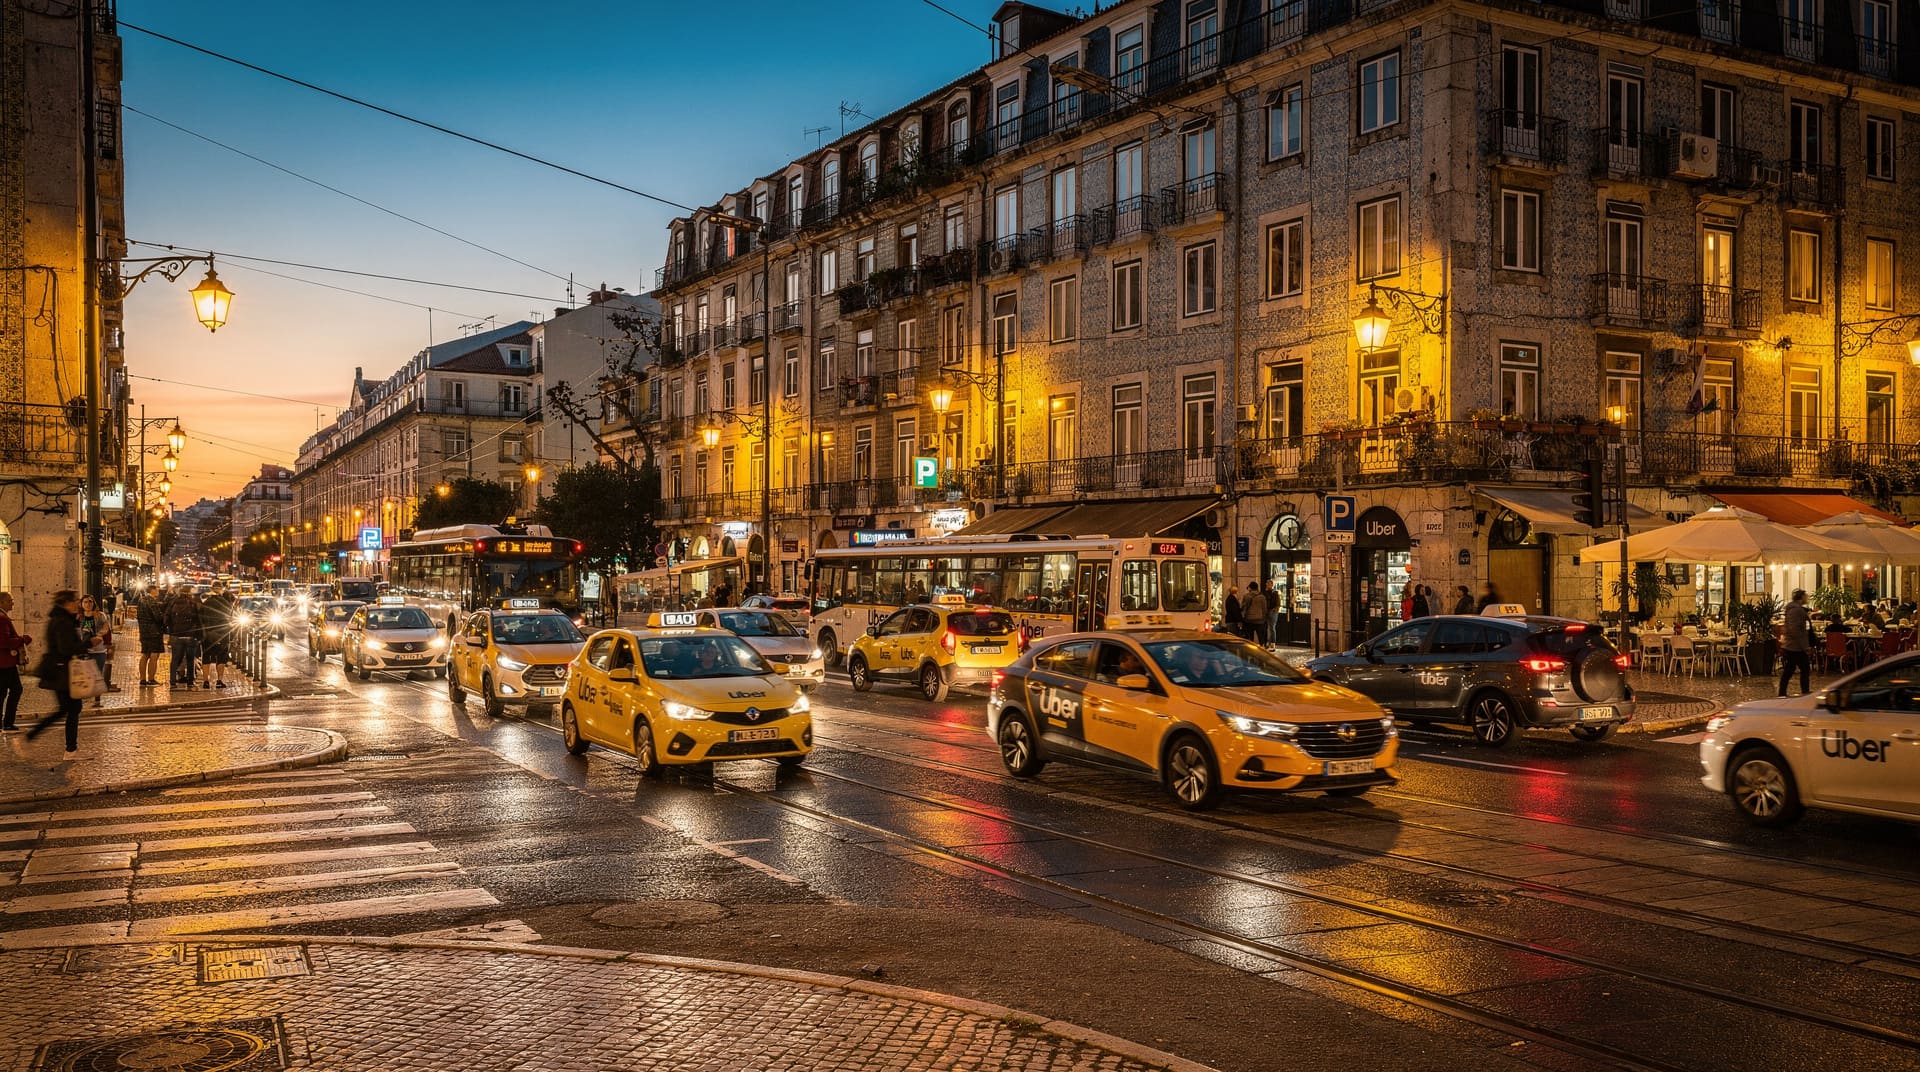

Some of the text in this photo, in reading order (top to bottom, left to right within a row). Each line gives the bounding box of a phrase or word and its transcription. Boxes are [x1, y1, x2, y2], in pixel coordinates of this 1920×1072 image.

[917, 460, 935, 485] P
[1331, 500, 1350, 528] P
[1366, 520, 1396, 536] Uber
[1421, 671, 1449, 686] Uber
[727, 691, 766, 699] Uber
[1040, 687, 1079, 719] Uber
[1822, 729, 1891, 763] Uber
